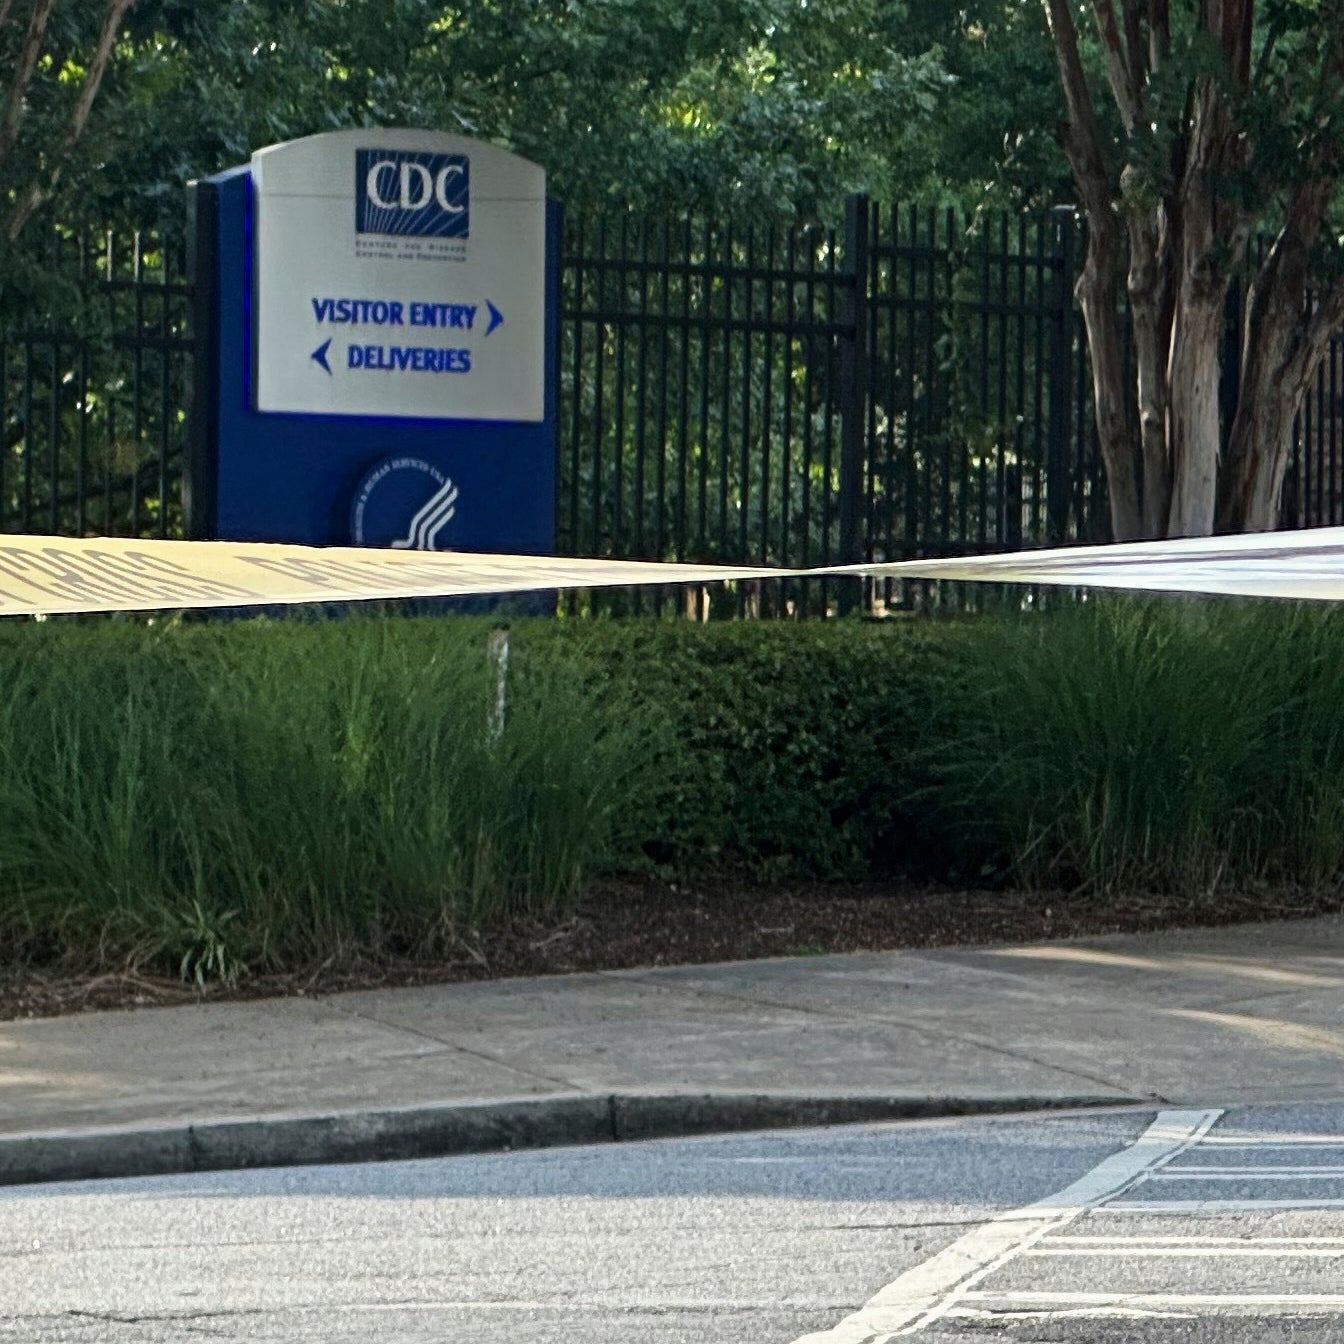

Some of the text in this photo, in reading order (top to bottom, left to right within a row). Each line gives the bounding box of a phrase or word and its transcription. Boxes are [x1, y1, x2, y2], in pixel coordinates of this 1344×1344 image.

[366, 160, 465, 213] CDC
[312, 297, 478, 329] VISITOR ENTRY
[348, 344, 472, 374] DELIVERIES
